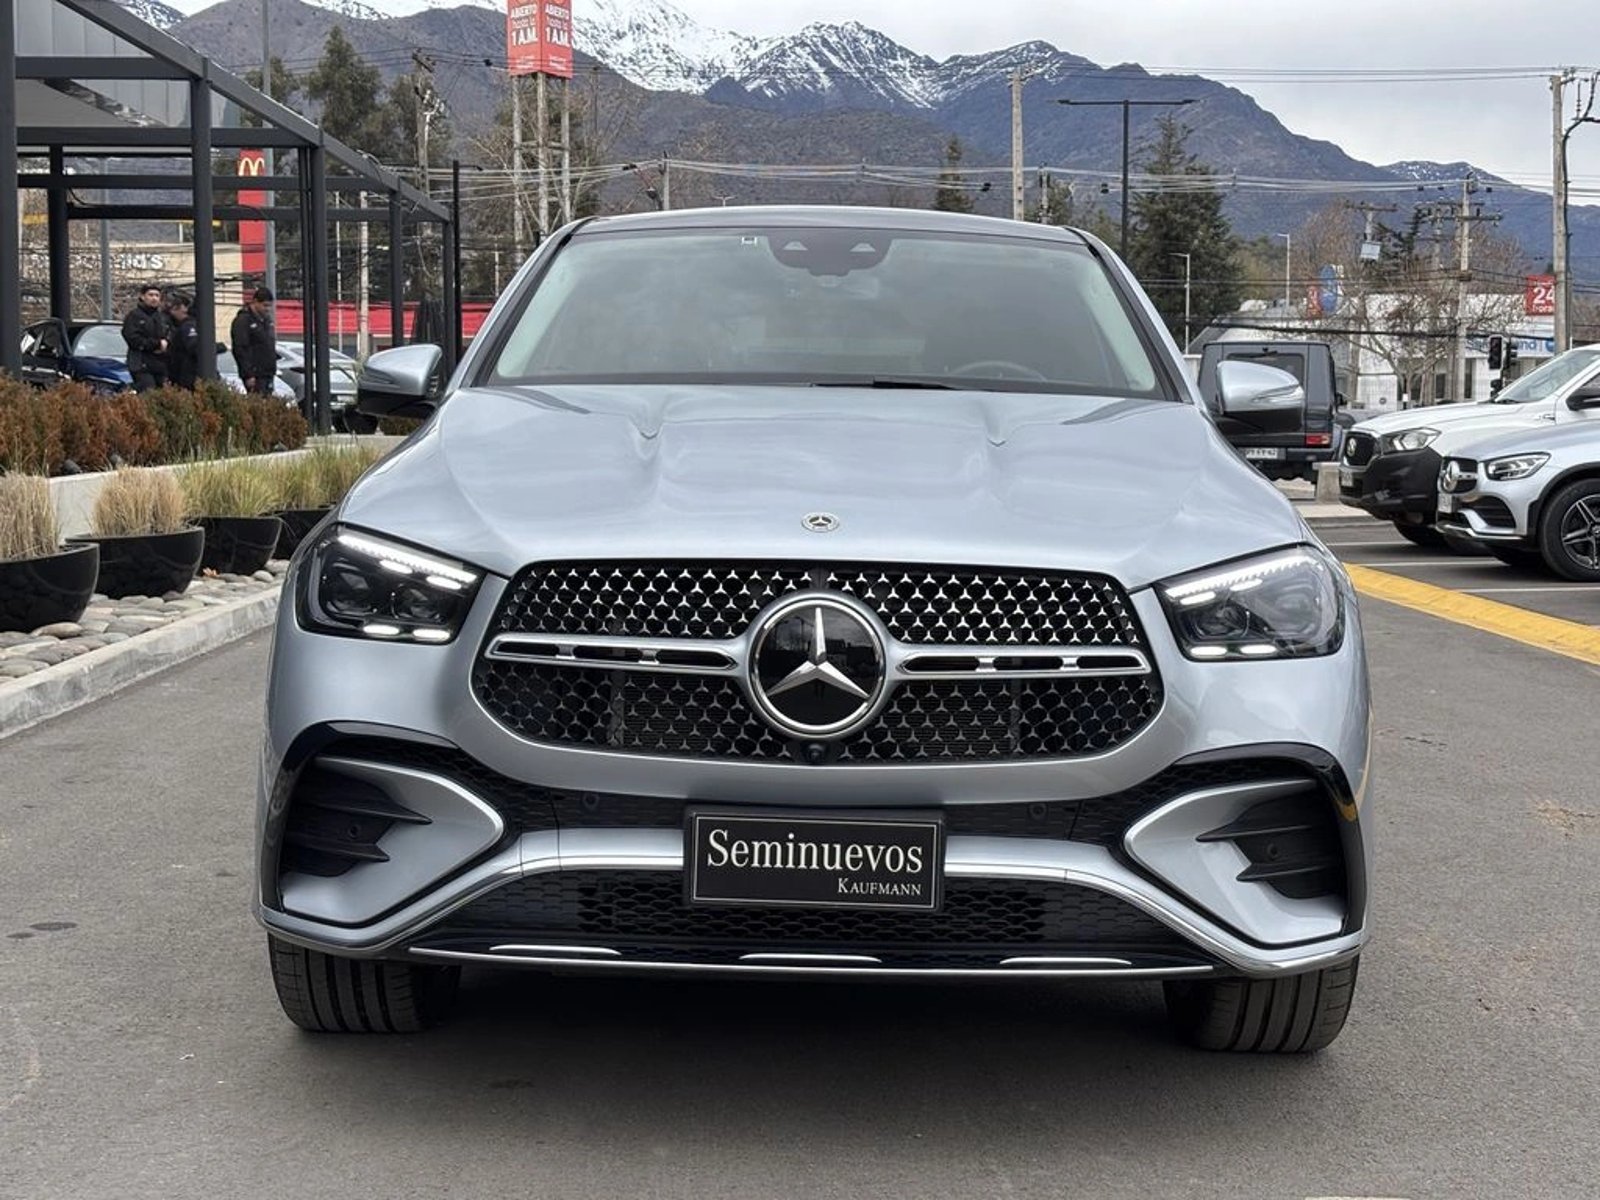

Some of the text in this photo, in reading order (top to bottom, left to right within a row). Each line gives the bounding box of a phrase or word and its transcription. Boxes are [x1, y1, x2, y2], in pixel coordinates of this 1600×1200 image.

[1533, 285, 1554, 304] 24
[707, 829, 923, 873] Seminuevos
[838, 878, 922, 896] KAUFMANN
